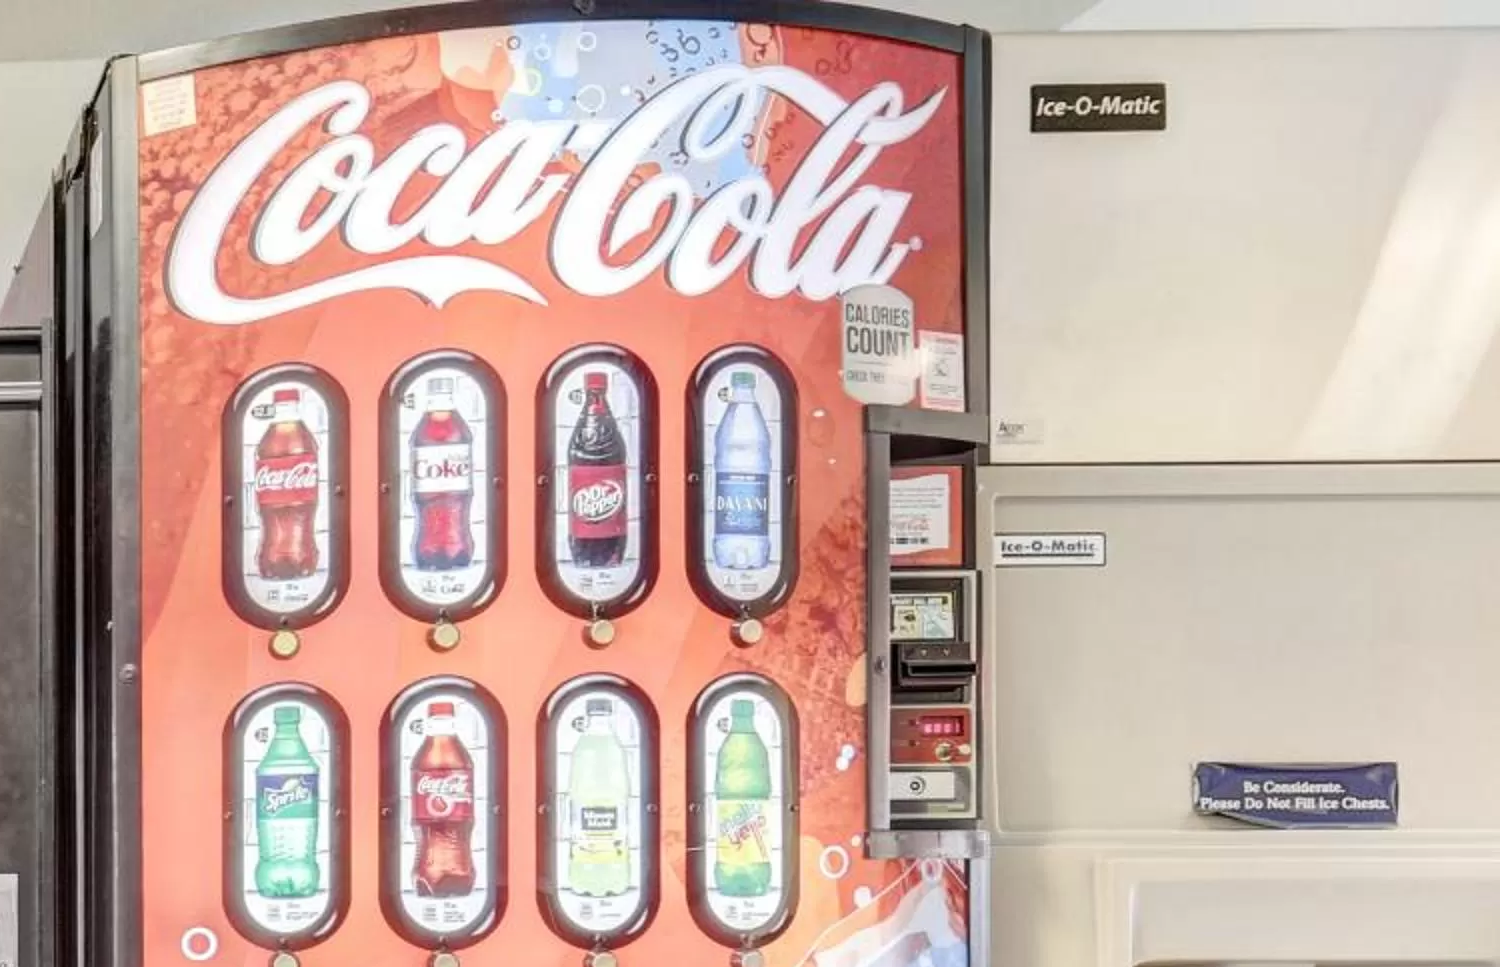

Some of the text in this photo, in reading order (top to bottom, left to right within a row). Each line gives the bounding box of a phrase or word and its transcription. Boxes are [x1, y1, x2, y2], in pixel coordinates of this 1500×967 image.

[1036, 95, 1161, 117] Ice-O-Matic
[163, 65, 948, 325] Coca-Cola
[845, 303, 910, 328] CALORIES
[846, 326, 909, 357] COUNT
[255, 457, 318, 491] Coca-Cola
[413, 458, 469, 480] Coke
[583, 484, 613, 501] Dr
[1001, 540, 1095, 552] Ice-O-Matic
[1243, 780, 1345, 794] Be Considerate.
[1201, 796, 1389, 810] Please Do Not Fill Ice Chests.
